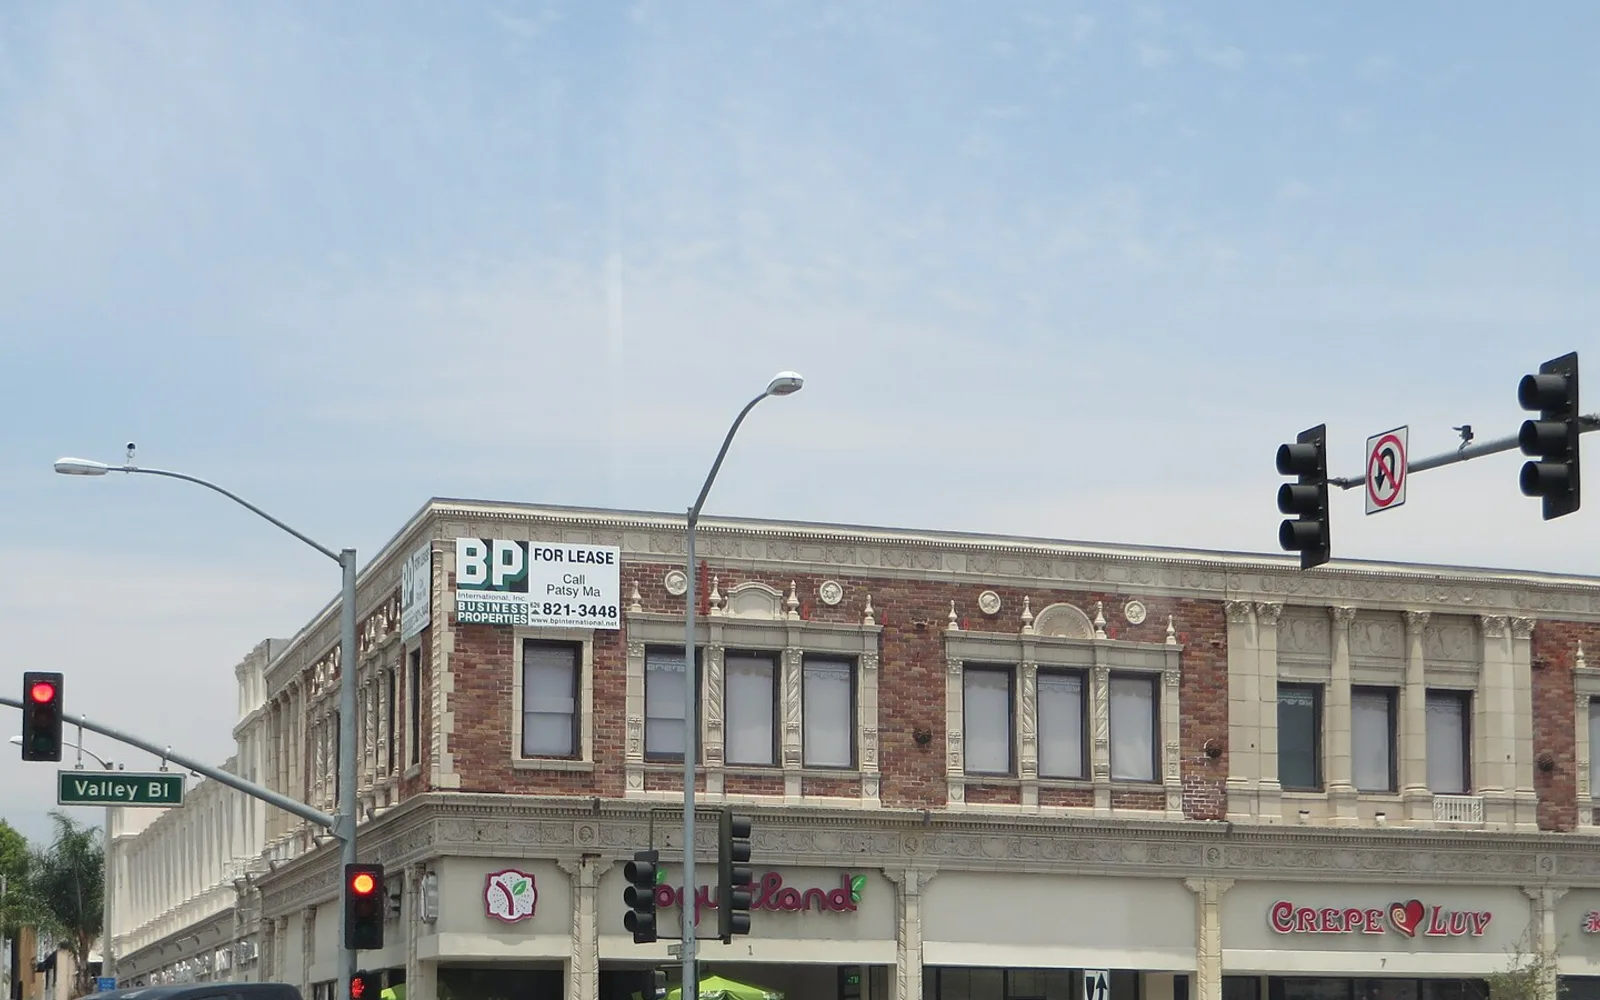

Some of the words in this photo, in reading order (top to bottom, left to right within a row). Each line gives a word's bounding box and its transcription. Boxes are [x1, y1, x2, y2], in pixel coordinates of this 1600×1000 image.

[456, 537, 525, 587] BP
[534, 548, 563, 562] FOR
[568, 550, 614, 565] LEASE
[563, 573, 586, 585] Call
[546, 584, 580, 599] Patsy
[583, 587, 601, 598] Ma
[457, 601, 528, 614] BUSINESS
[542, 602, 618, 618] 821-3448
[457, 613, 528, 624] PROPERTIES
[75, 780, 138, 801] Valley
[148, 782, 169, 798] Bl
[1271, 900, 1386, 935] CREPE
[1424, 905, 1493, 937] LUV
[1379, 958, 1387, 969] 7
